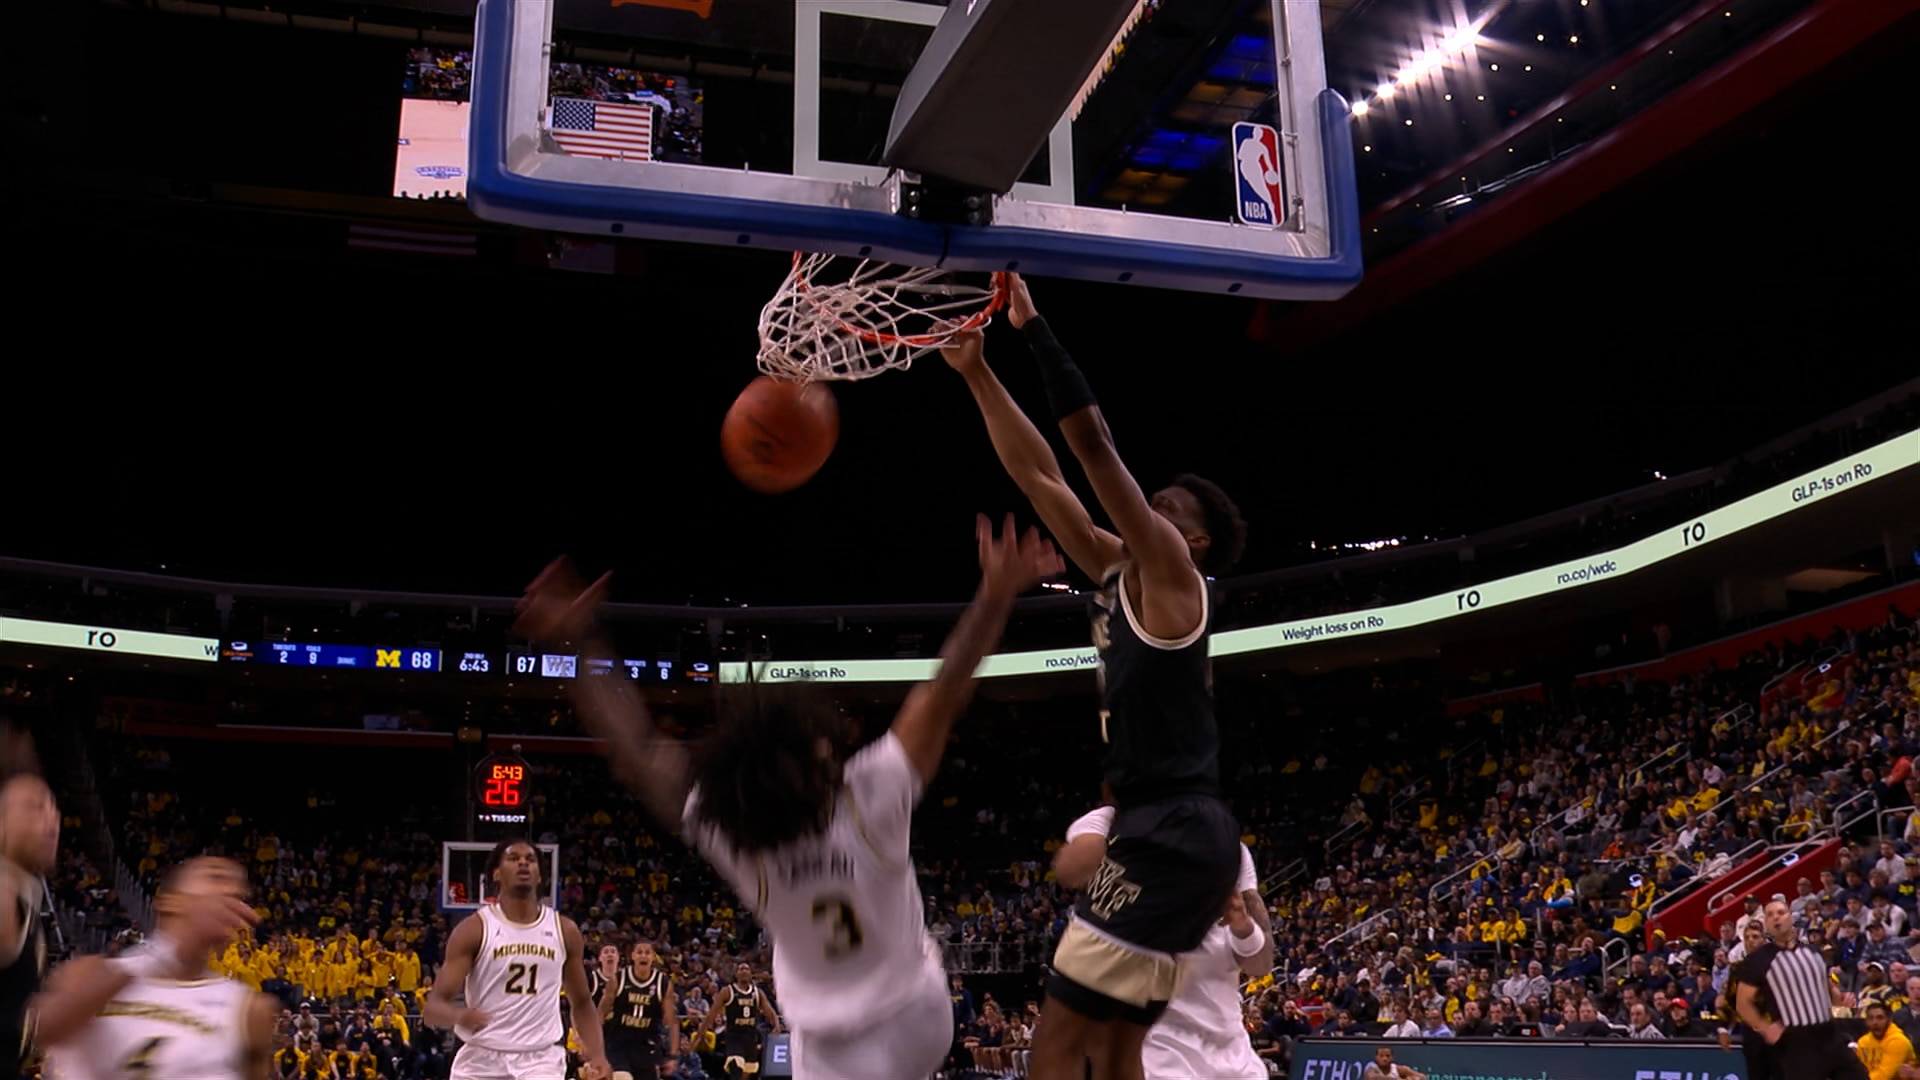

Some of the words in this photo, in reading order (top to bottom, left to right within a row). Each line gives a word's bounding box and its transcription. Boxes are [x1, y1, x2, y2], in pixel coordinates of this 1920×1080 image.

[1244, 201, 1268, 220] NBA
[1792, 477, 1835, 502] GLP-1s
[1836, 471, 1852, 486] on
[1854, 463, 1872, 479] Ro
[1682, 522, 1705, 546] ro
[1557, 560, 1616, 584] ro.co/wdc
[1457, 591, 1481, 611] ro
[1282, 625, 1324, 640] Weight
[1325, 622, 1348, 634] loss
[1350, 620, 1365, 631] on
[1367, 616, 1384, 628] Ro
[87, 630, 116, 648] ro
[280, 651, 288, 663] 2
[309, 652, 317, 664] 9
[376, 649, 401, 667] M
[411, 651, 432, 668] 68
[459, 659, 489, 672] 6:43
[516, 656, 537, 673] 67
[1045, 653, 1097, 668] ro.co/wd
[630, 667, 639, 679] 3
[660, 668, 669, 680] 6
[770, 667, 810, 679] GLP-1s
[812, 668, 828, 679] on
[830, 667, 846, 678] Ro
[493, 765, 523, 780] 6:43
[486, 779, 520, 805] 26
[491, 814, 526, 823] TISSOT
[811, 892, 863, 961] 3
[493, 943, 555, 960] MICHIGAN
[505, 962, 540, 995] 21
[628, 992, 651, 1005] WAKE
[633, 1004, 644, 1017] 11
[1303, 1059, 1375, 1080] ETHO
